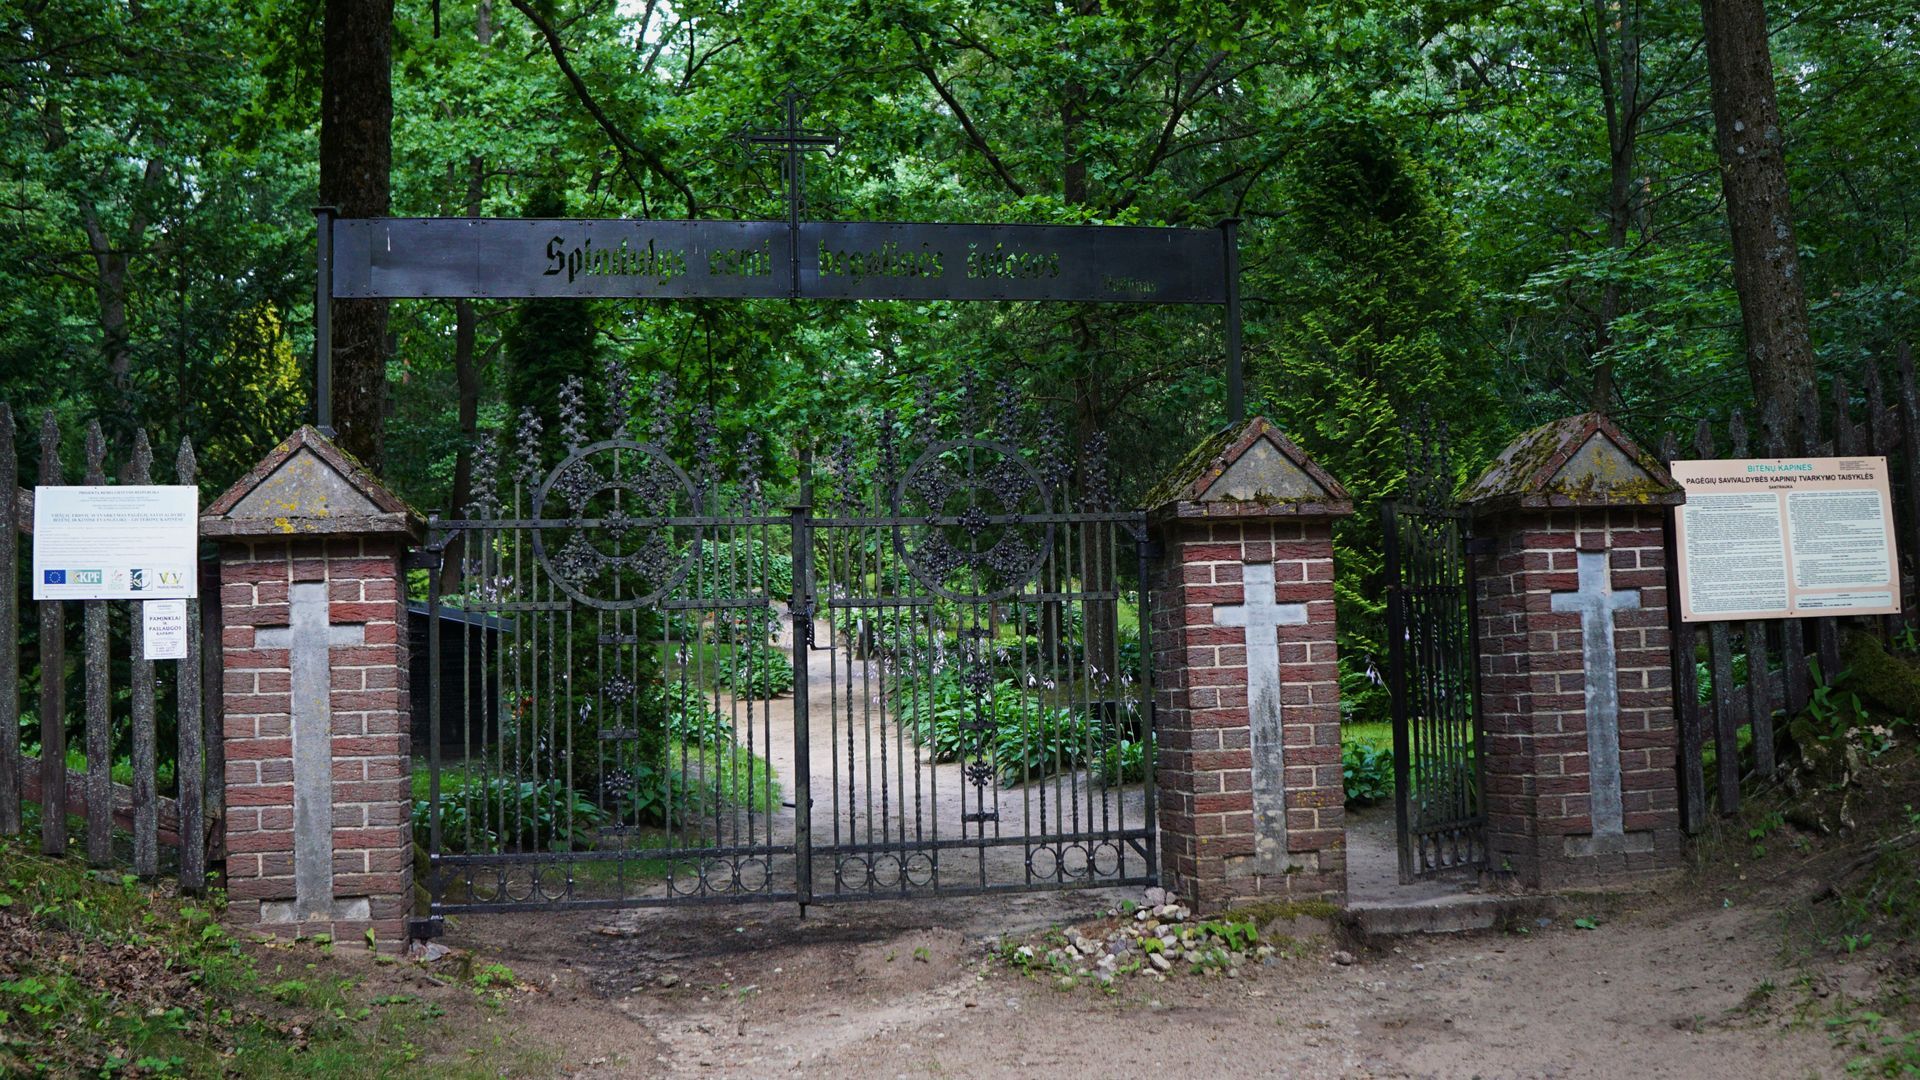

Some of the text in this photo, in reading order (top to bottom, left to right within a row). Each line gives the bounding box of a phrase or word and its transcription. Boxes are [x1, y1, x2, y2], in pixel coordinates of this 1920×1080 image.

[543, 235, 687, 285] Spindulys
[709, 239, 772, 277] esmi
[1718, 475, 1768, 484] SAVIVALDYBĖS
[1770, 475, 1797, 483] KAPINIŲ
[1799, 474, 1836, 482] TVARKYMO
[1837, 472, 1874, 480] TAISYKLĖS
